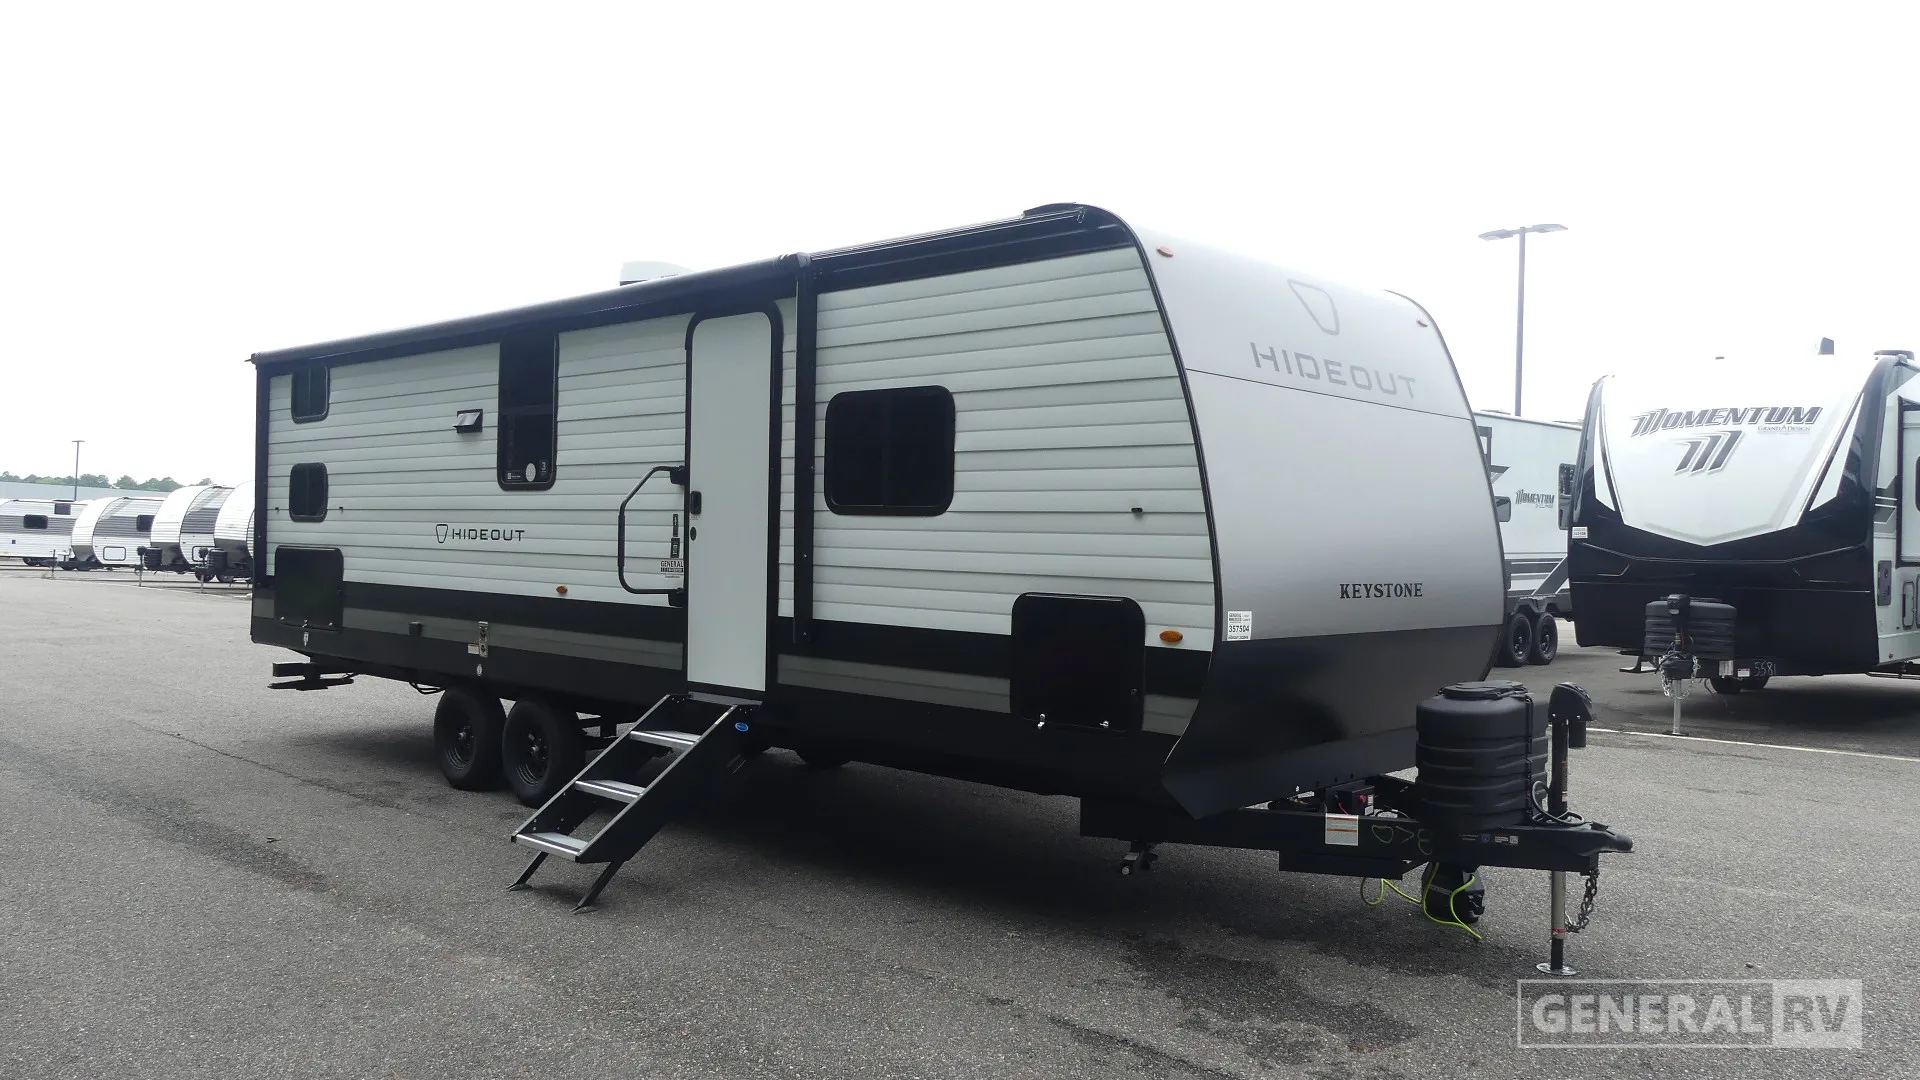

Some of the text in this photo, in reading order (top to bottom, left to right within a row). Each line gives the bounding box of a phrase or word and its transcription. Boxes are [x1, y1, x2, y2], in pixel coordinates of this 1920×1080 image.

[1250, 341, 1416, 399] HIDEOUT
[1630, 406, 1823, 437] MOMENTUM
[452, 528, 525, 542] HIDEOUT
[1339, 583, 1423, 599] KEYSTONE
